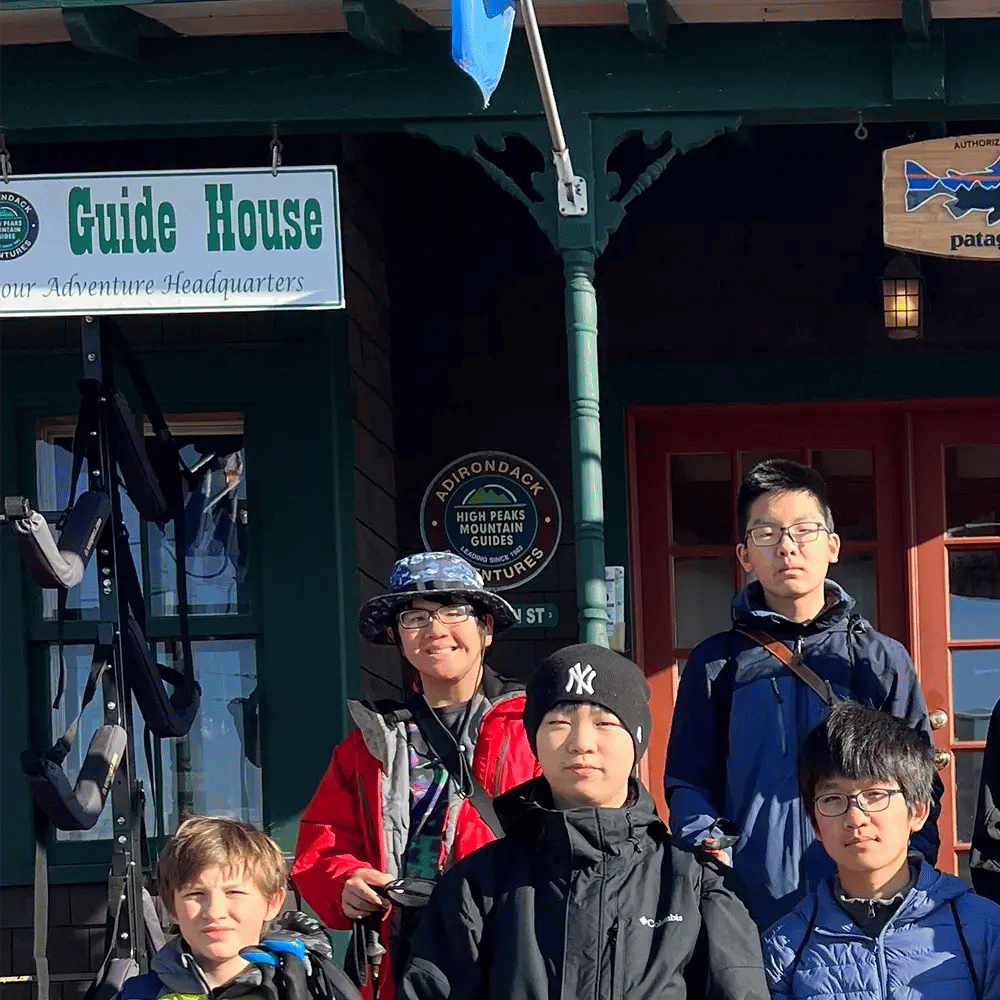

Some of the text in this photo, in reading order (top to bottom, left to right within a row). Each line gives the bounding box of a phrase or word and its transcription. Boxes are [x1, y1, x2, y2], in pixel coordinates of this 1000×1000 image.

[68, 183, 323, 256] Guide House
[43, 272, 155, 298] Adventure
[162, 269, 305, 301] Headquarters
[435, 459, 545, 503] ADIRONDACK
[456, 509, 526, 523] HIGH PEAKS
[459, 522, 524, 536] MOUNTAIN
[470, 534, 514, 547] GUIDES
[460, 545, 488, 563] LEADING
[489, 555, 510, 564] SINCE
[525, 607, 545, 624] ST
